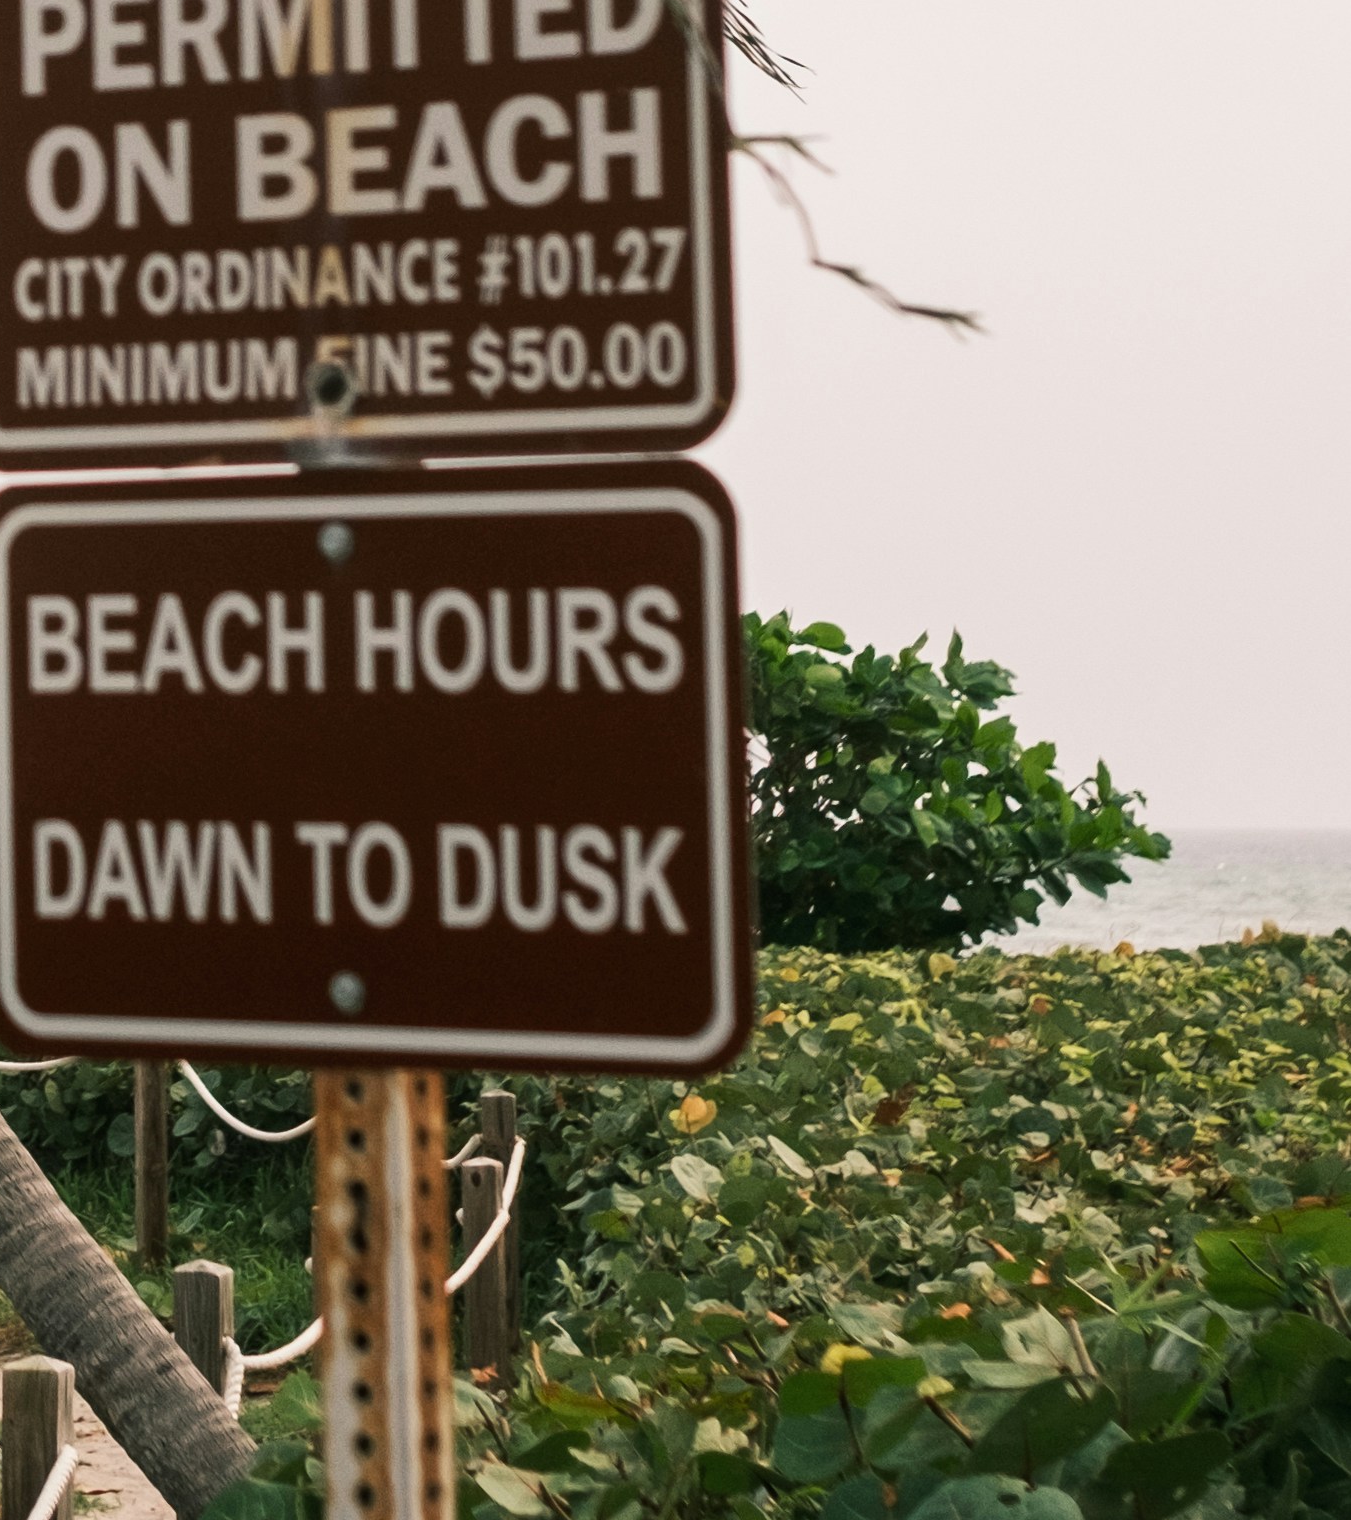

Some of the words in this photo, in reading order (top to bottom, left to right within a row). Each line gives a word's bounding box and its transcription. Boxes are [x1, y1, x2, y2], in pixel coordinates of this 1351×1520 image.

[27, 121, 191, 233] ON
[235, 88, 662, 221] BEACH
[14, 255, 129, 322] CITY
[138, 241, 460, 315] ORDINANCE
[477, 228, 685, 304] #101.27
[16, 336, 297, 408] MINIMUM
[468, 322, 686, 397] $50.00
[27, 591, 325, 694] BEACH
[354, 587, 683, 695] HOURS
[32, 819, 272, 924] DAWN
[295, 823, 411, 927] TO
[438, 825, 688, 934] DUSK
